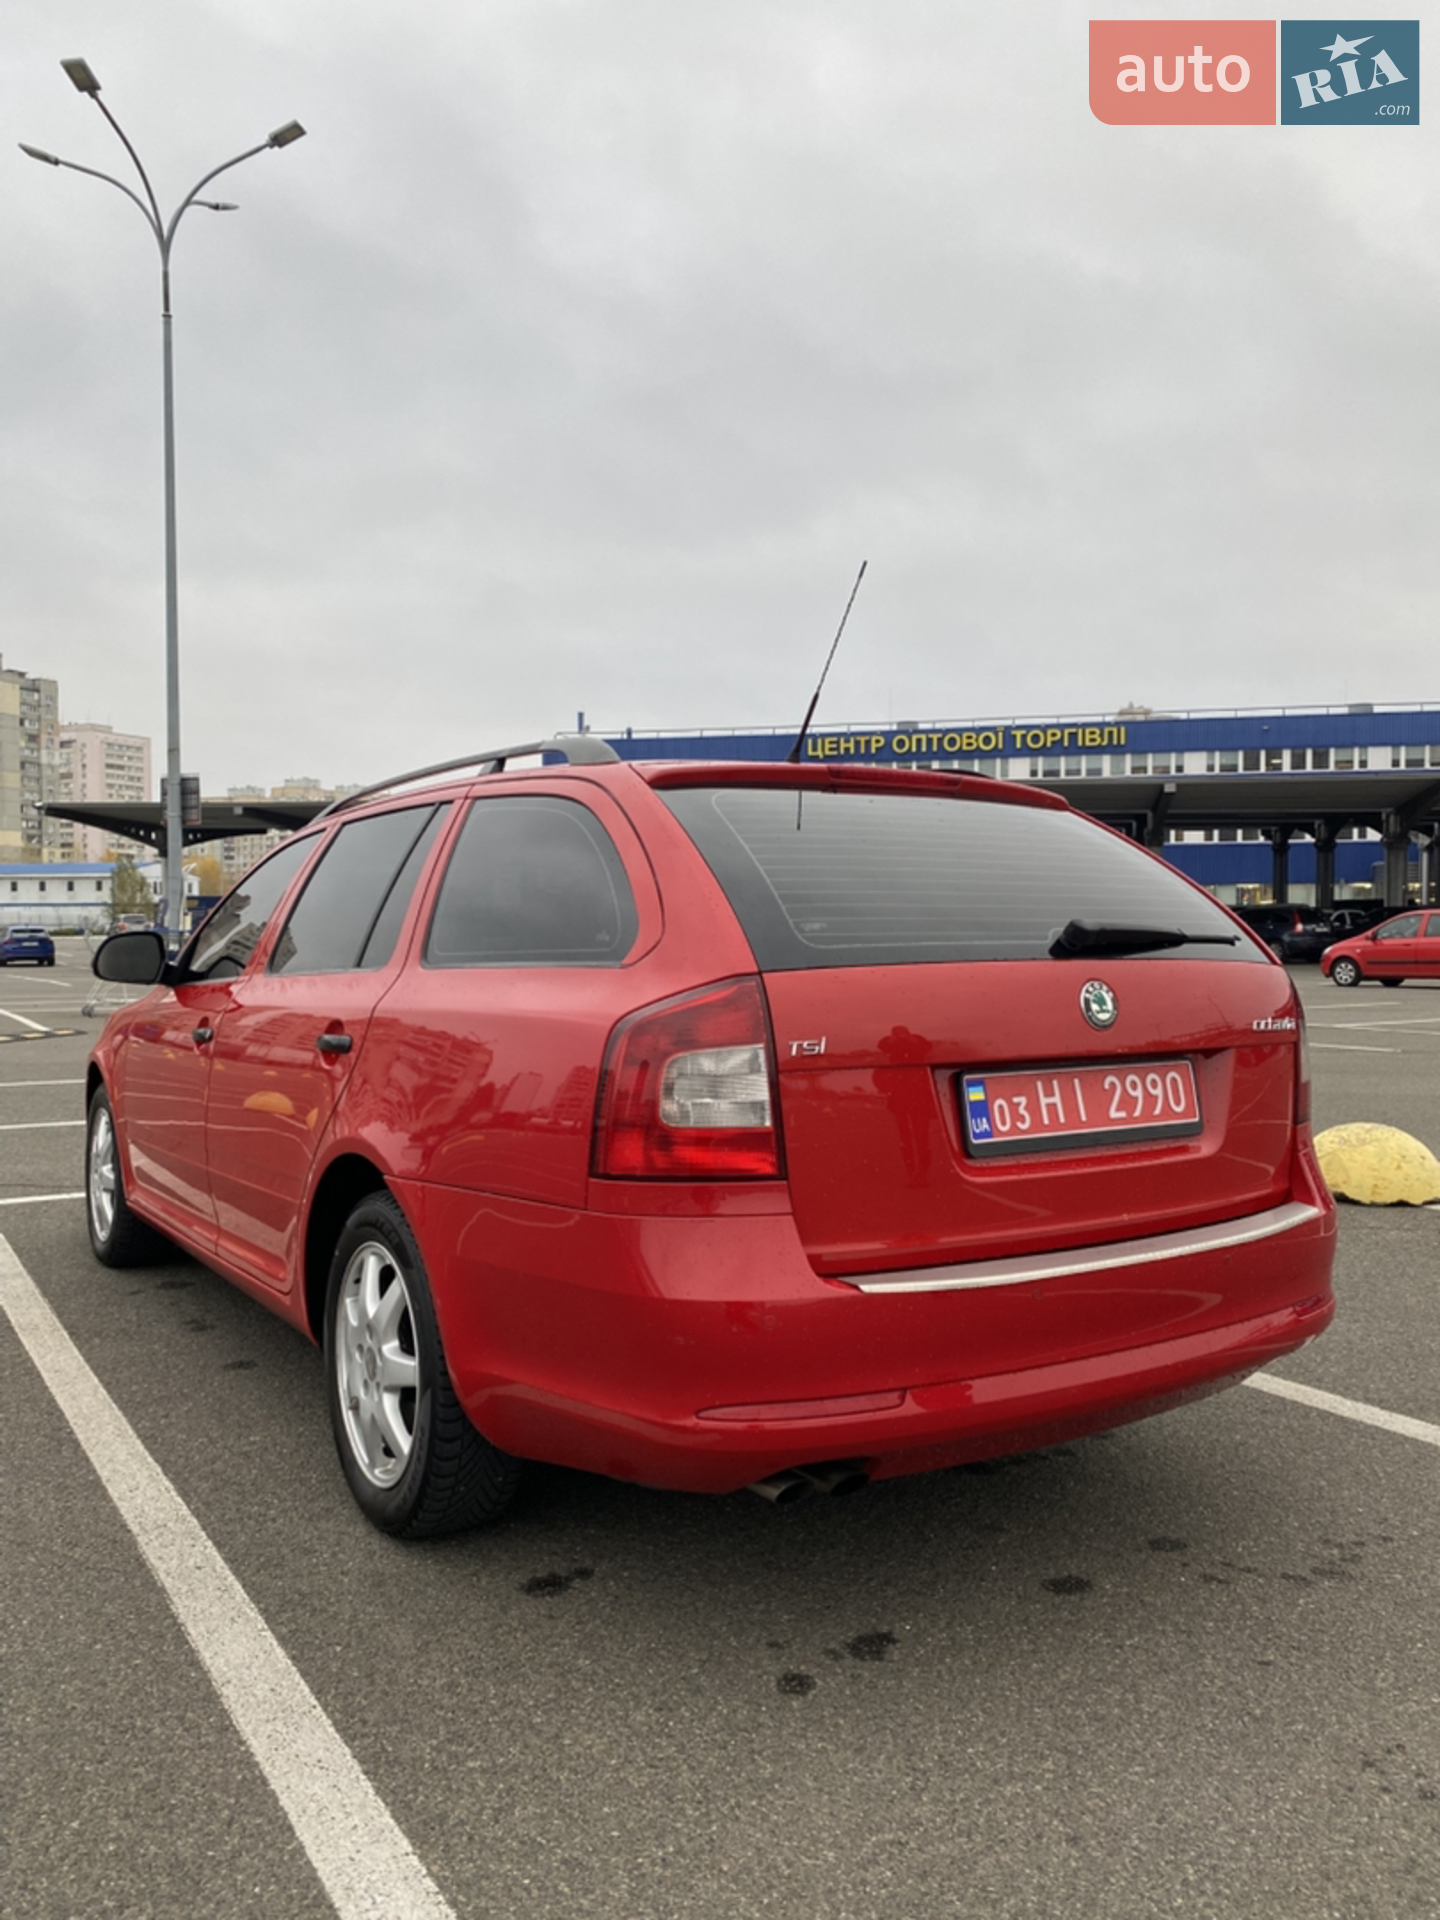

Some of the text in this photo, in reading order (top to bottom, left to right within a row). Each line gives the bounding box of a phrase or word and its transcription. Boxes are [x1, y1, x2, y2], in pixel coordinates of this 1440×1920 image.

[806, 725, 1127, 759] ЦЕНТР ОПТОВОЇ ТОРГІВЛІ
[788, 1035, 827, 1057] TSI
[992, 1096, 1032, 1132] 03
[1102, 1070, 1187, 1119] 2990
[971, 1116, 991, 1134] UA
